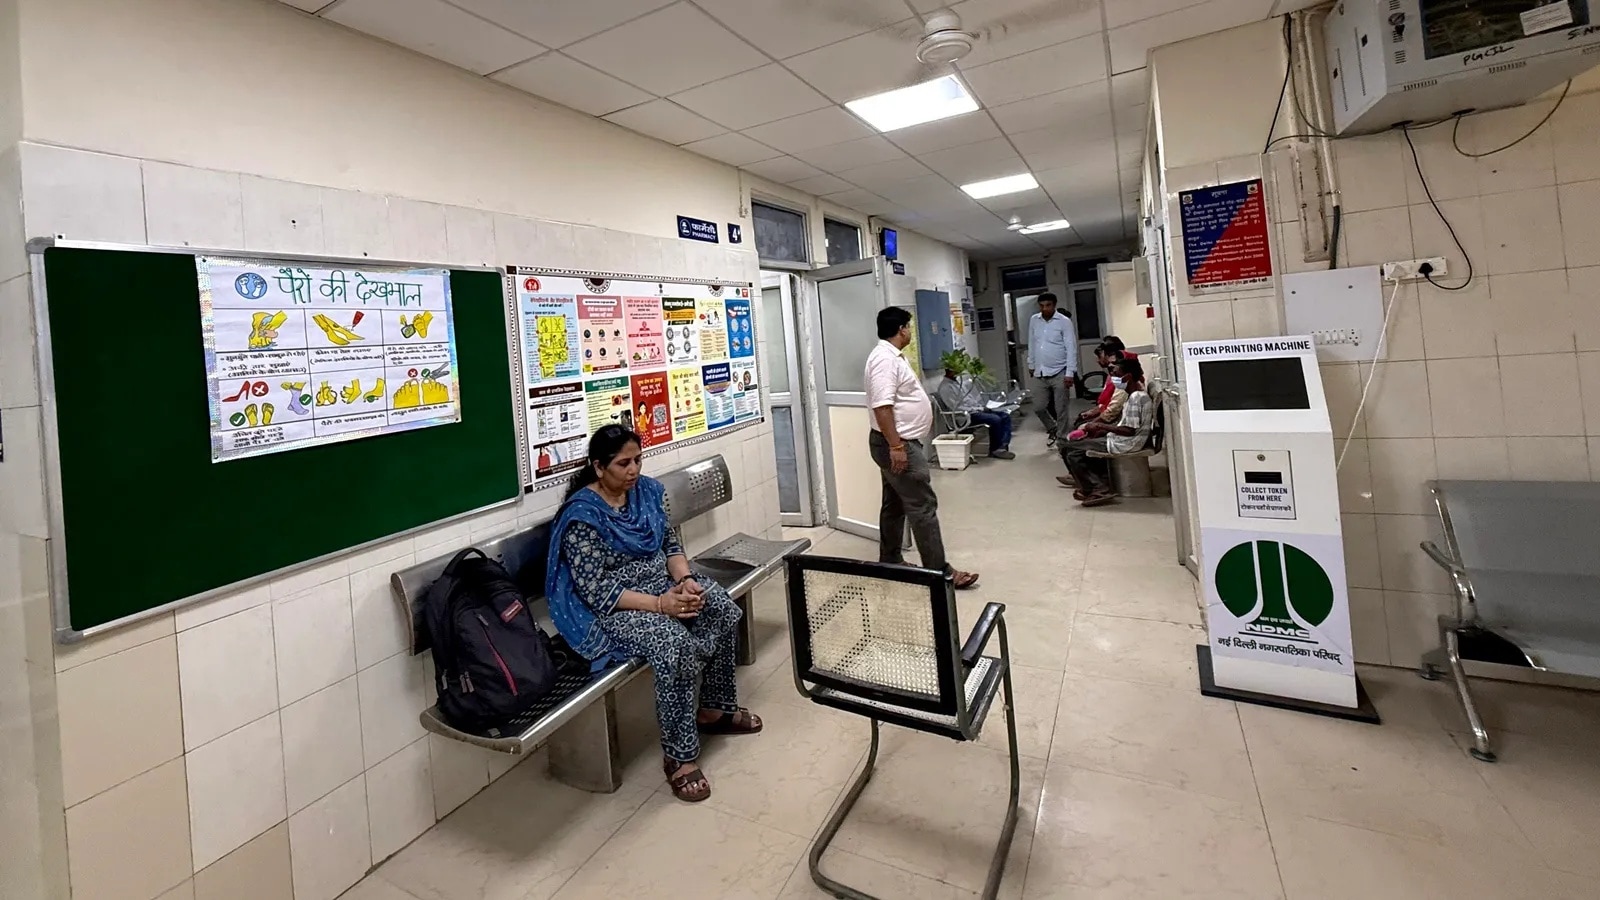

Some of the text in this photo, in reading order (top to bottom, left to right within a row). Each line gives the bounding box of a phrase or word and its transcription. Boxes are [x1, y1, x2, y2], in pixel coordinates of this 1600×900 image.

[1211, 190, 1228, 198] सूचना
[692, 232, 716, 240] PHARMACY
[272, 268, 422, 306] पैरों की देखभाल
[1188, 340, 1310, 356] TOKEN PRINTING MACHINE
[1245, 623, 1310, 639] NDMC
[1218, 636, 1343, 665] नई दिल्ली नगरपालिका परिषद्
